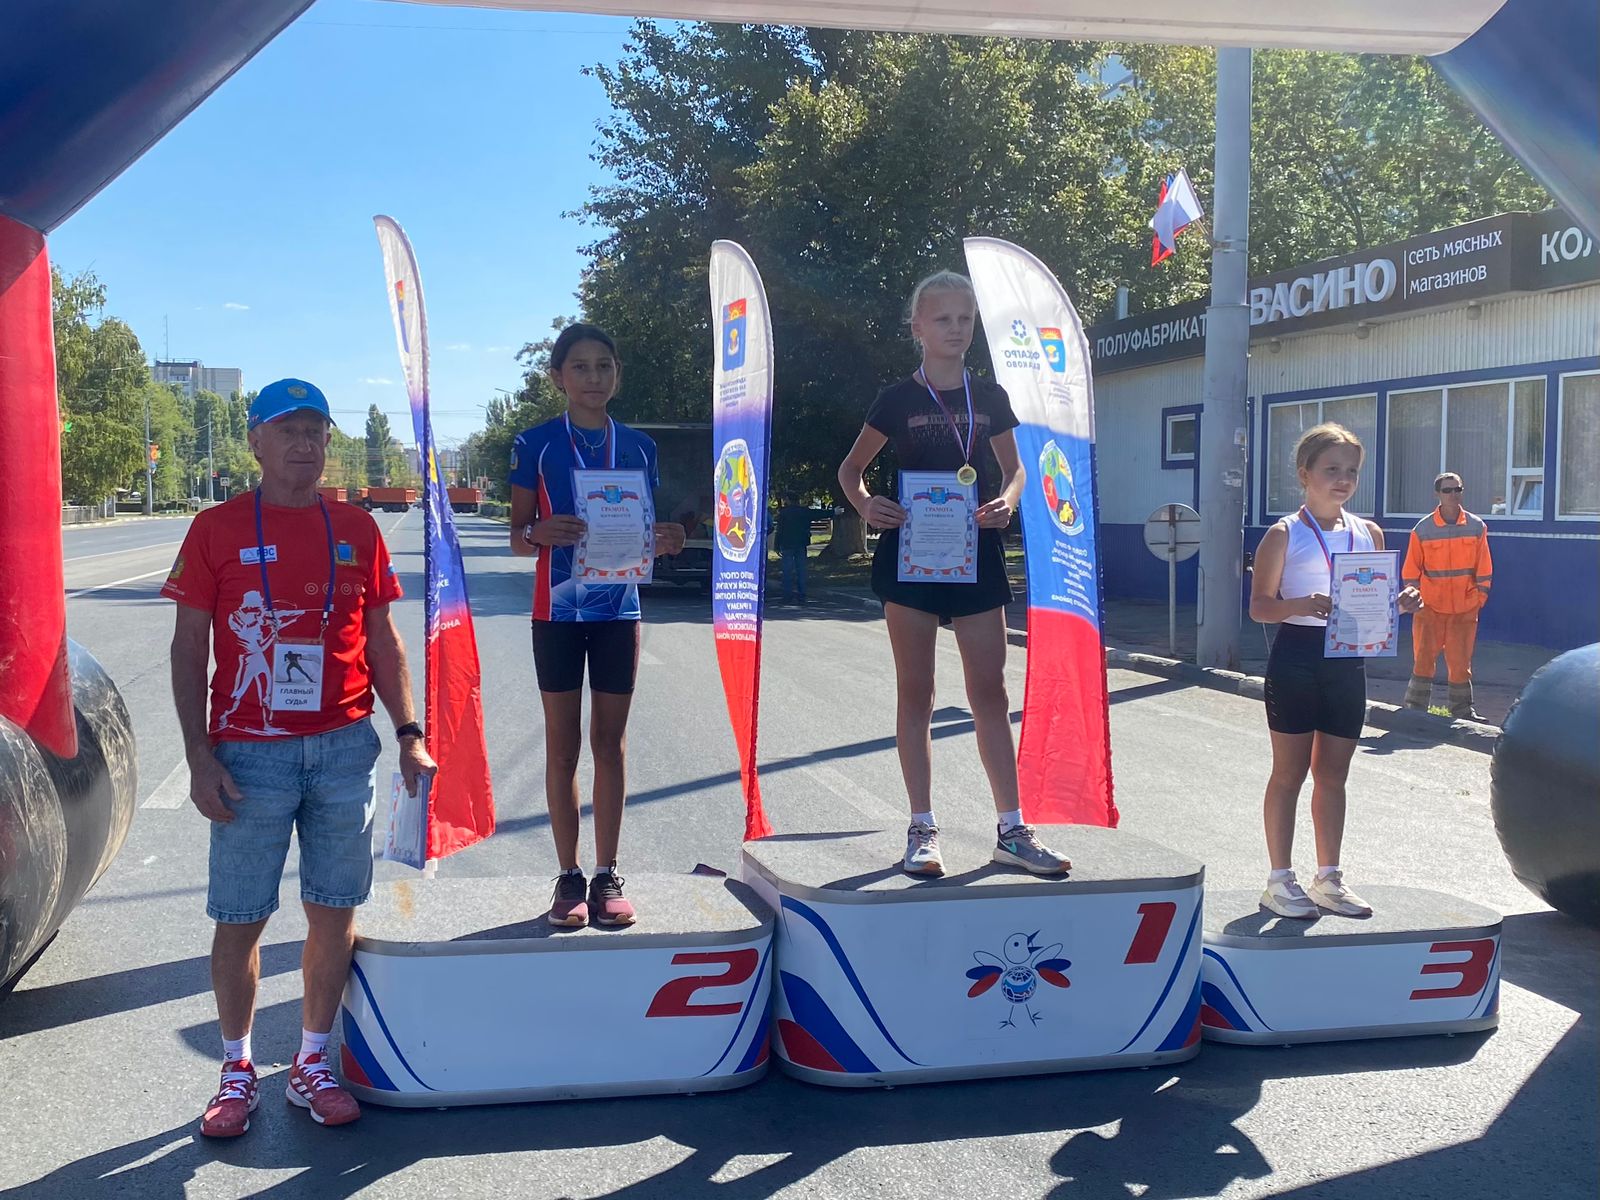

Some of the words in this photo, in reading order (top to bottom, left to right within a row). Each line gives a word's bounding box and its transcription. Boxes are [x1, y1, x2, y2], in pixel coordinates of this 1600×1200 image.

[1408, 246, 1440, 265] сеть
[1409, 265, 1487, 294] магазинов
[1250, 258, 1397, 326] ВАСИНО
[285, 698, 308, 706] СУДЬЯ
[1123, 902, 1177, 965] 1
[645, 948, 759, 1018] 2
[1409, 939, 1495, 1000] 3
